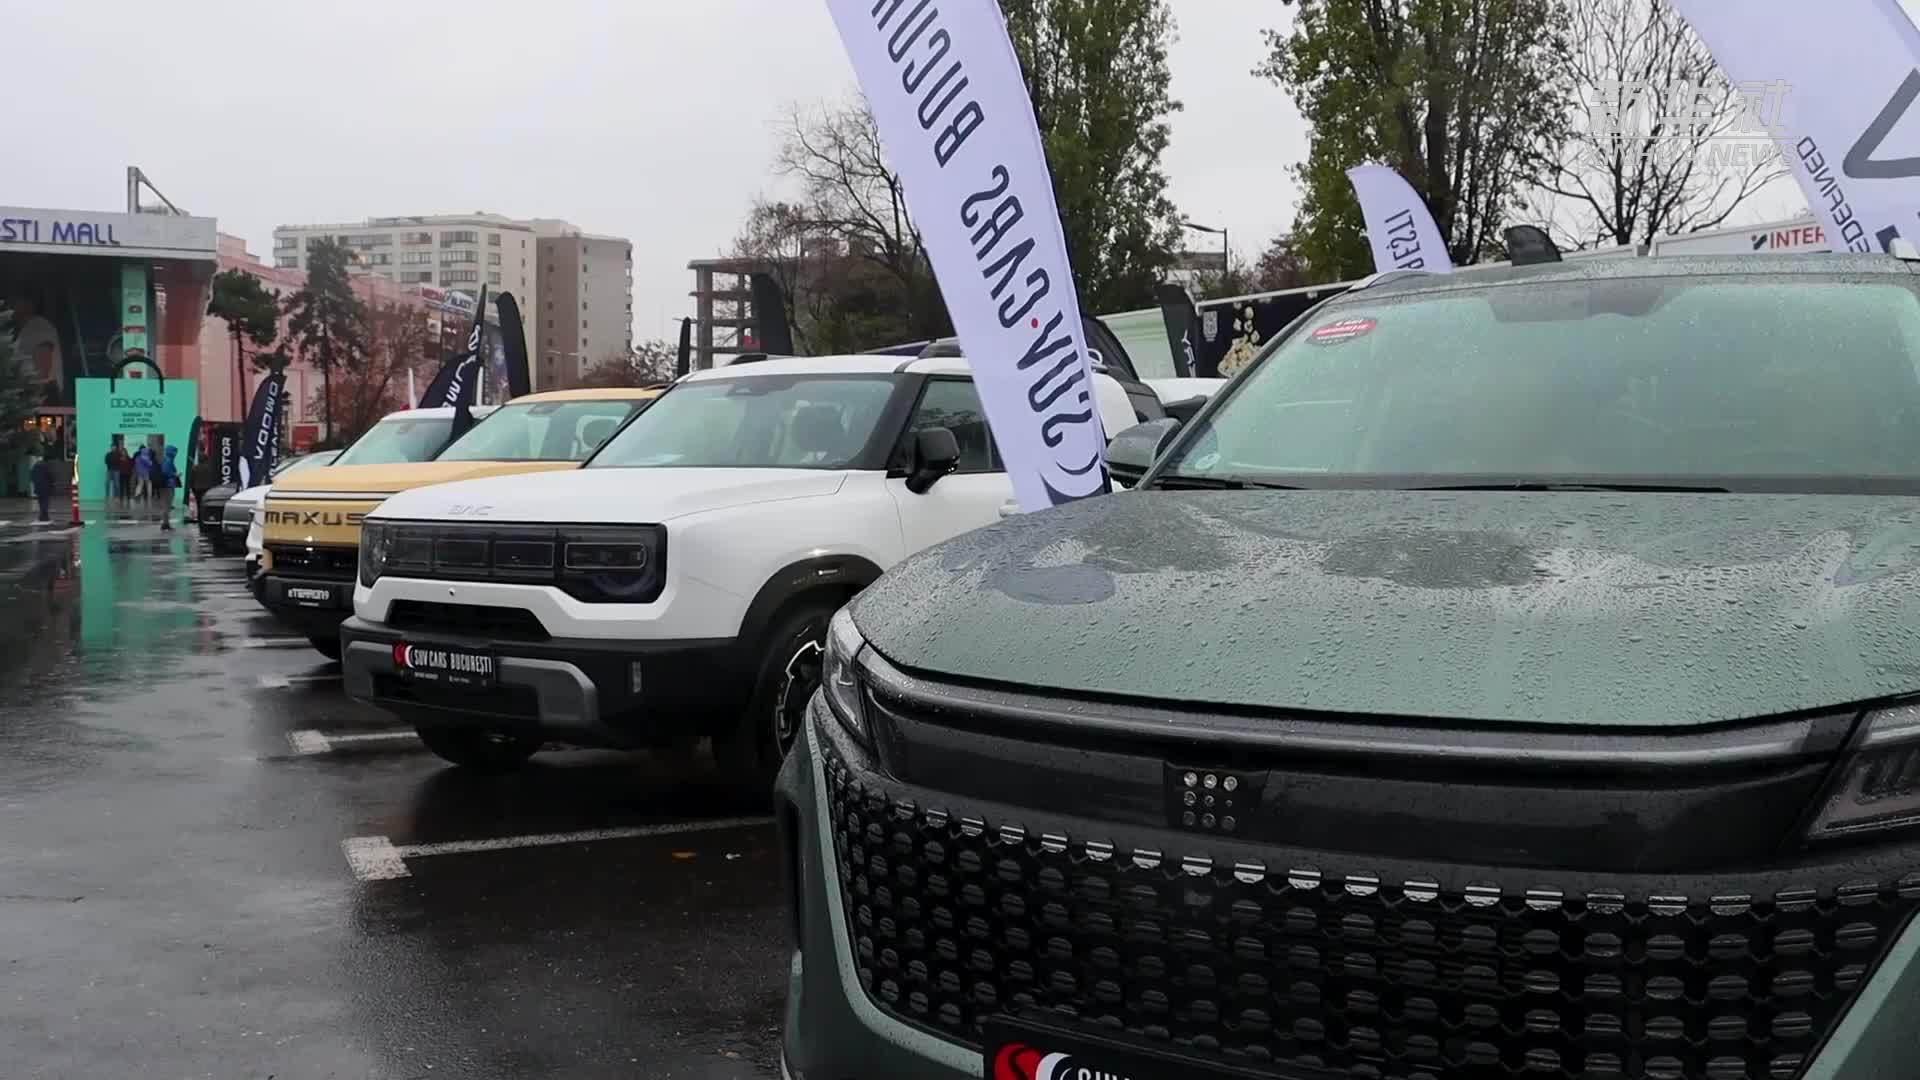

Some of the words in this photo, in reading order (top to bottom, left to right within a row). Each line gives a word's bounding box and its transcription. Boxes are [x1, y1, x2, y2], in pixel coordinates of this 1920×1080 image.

[0, 218, 40, 242] STI
[51, 221, 121, 246] MALL
[221, 436, 232, 486] MOTOR
[264, 511, 365, 526] MAXUS
[429, 650, 448, 669] CARS
